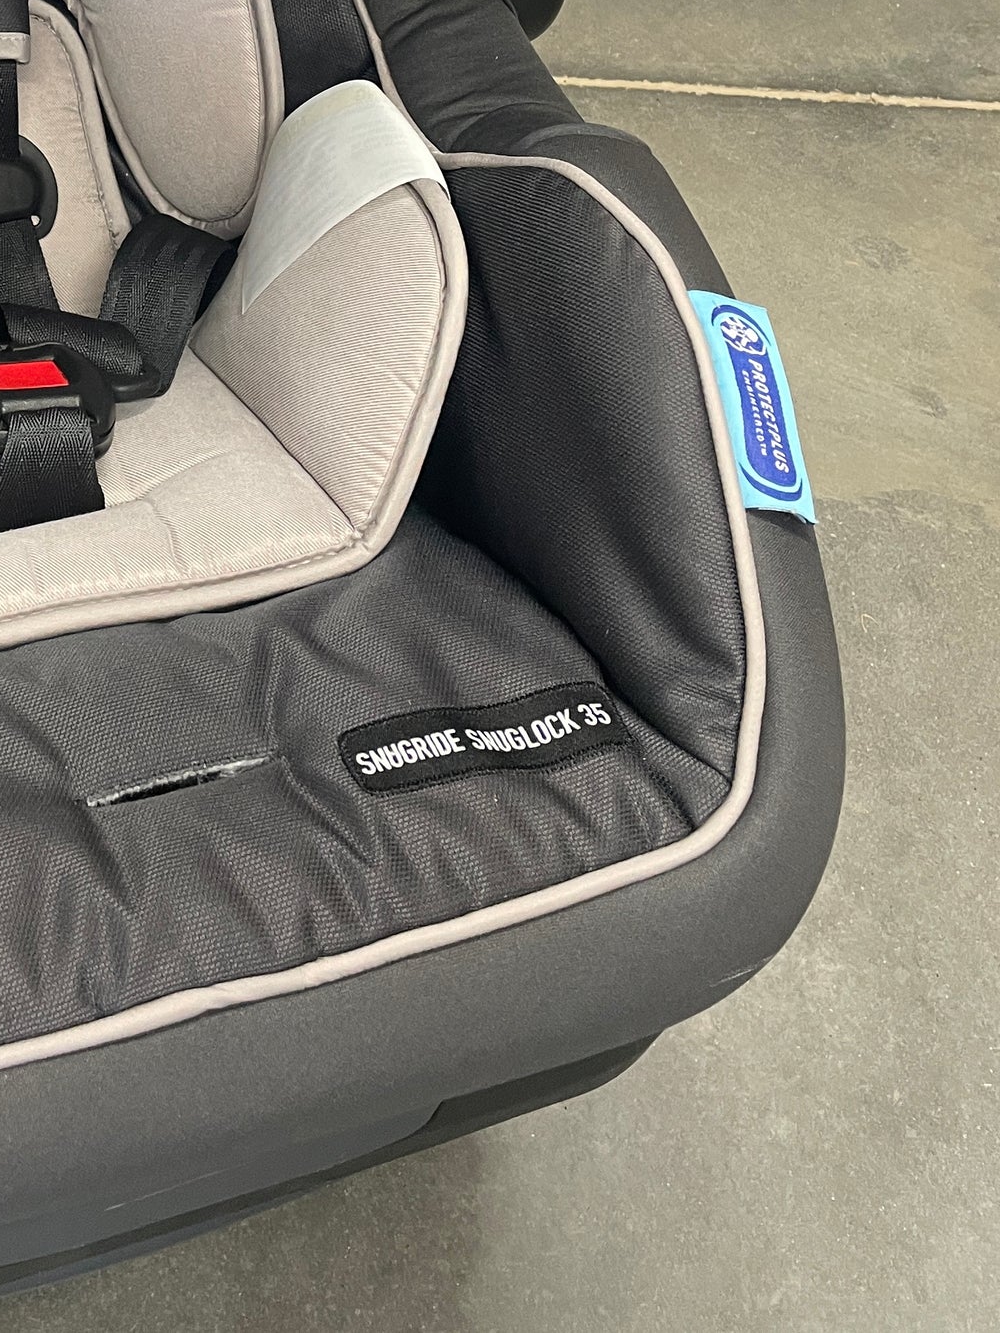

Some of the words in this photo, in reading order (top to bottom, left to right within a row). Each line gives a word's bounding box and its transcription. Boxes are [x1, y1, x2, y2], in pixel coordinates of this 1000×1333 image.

[748, 358, 789, 474] PROTECTPLUS
[465, 708, 581, 752] SNUGLOCK
[577, 703, 612, 725] 35
